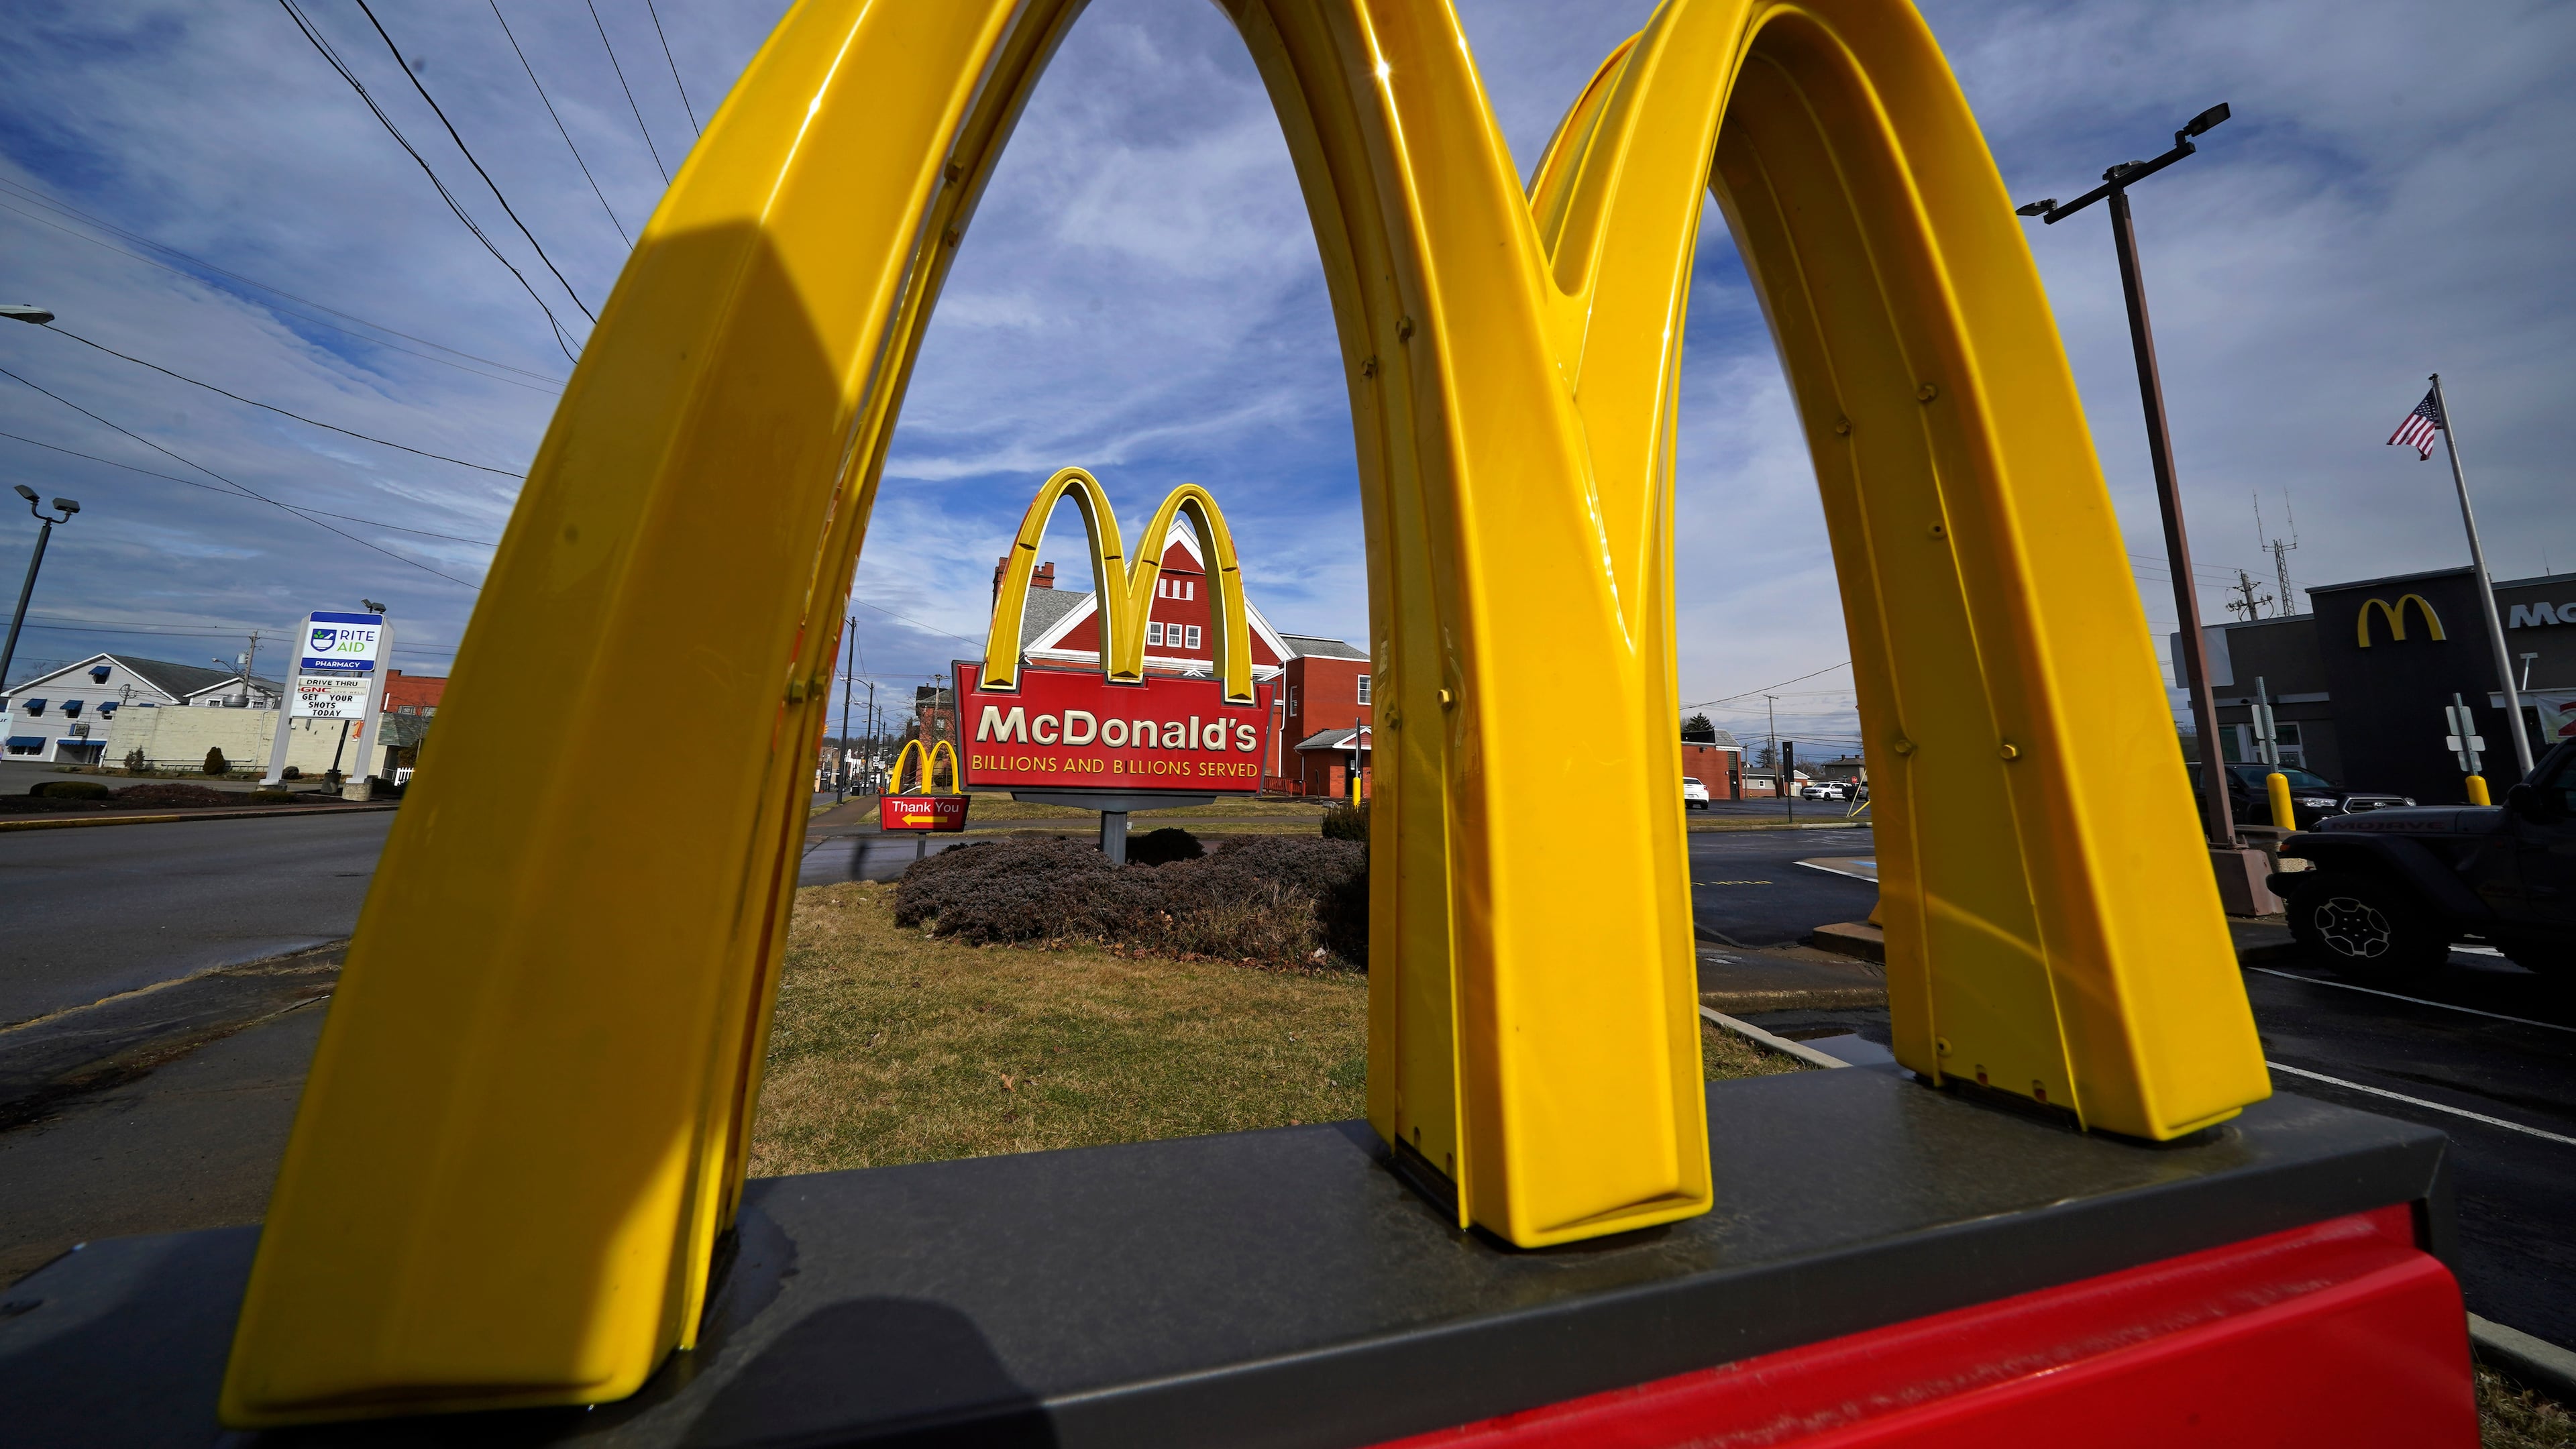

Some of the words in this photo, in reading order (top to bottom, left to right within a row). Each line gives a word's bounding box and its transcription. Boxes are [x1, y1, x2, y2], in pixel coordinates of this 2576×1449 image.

[339, 629, 376, 641] RITE
[336, 641, 365, 652] AID
[315, 660, 361, 668] PHARMACY
[975, 704, 1258, 753] McDonald's
[971, 754, 1057, 773] BILLIONS
[1062, 758, 1105, 774] AND
[1197, 762, 1258, 779] SERVED
[892, 801, 931, 813] Thank
[934, 802, 960, 813] You
[2331, 821, 2445, 830] MOJAVE
